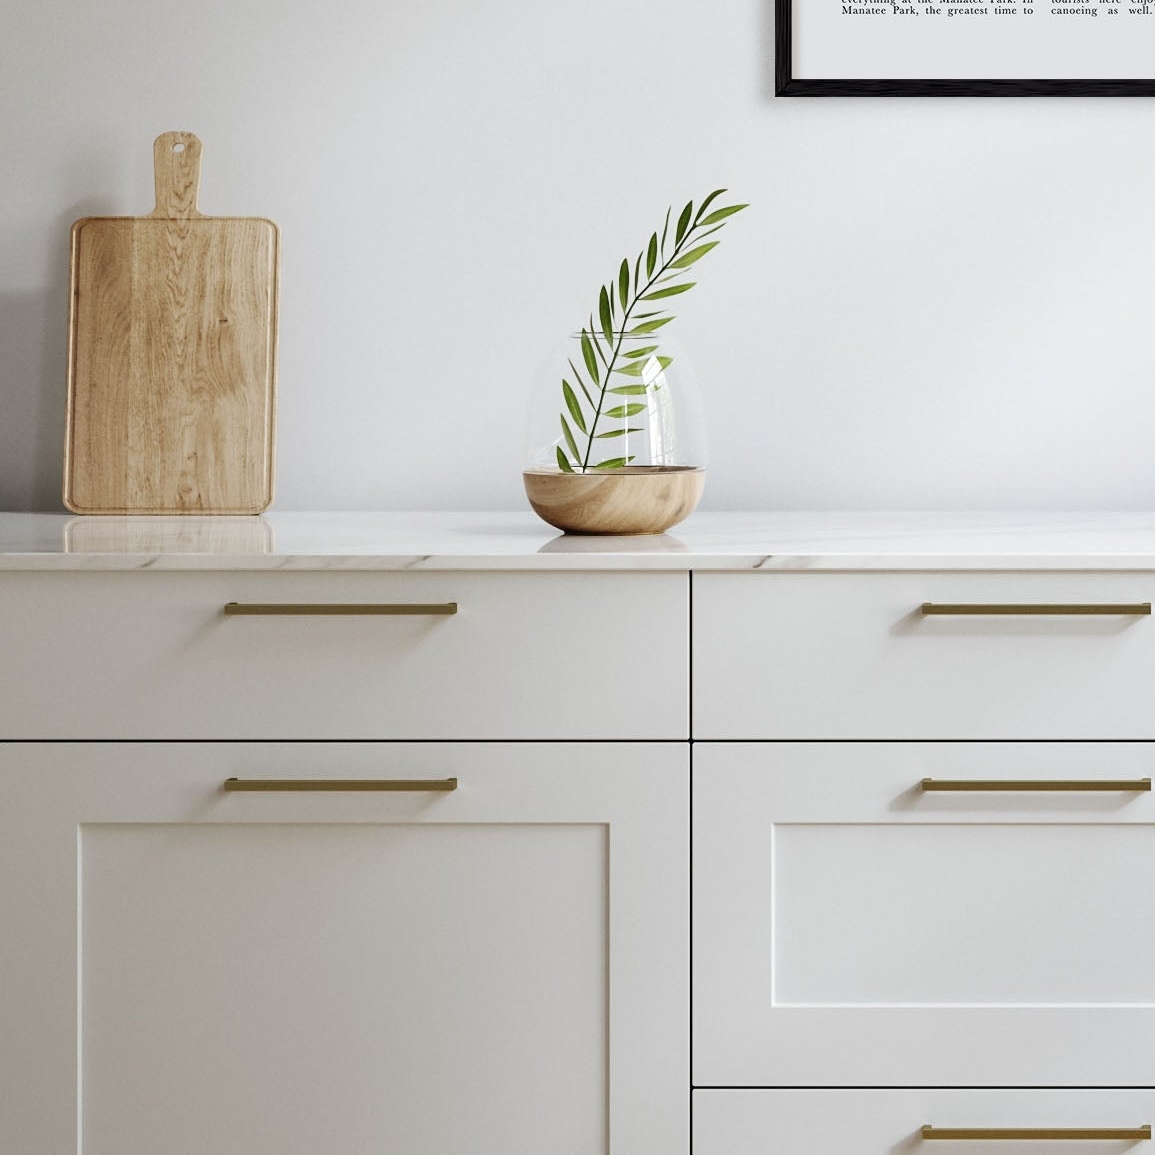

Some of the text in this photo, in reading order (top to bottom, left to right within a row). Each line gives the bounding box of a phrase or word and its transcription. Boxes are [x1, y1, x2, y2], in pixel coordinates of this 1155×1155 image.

[842, 5, 1034, 17] Manatee Park, the greatest time to
[1051, 6, 1098, 17] canoeing
[1128, 5, 1152, 15] well.
